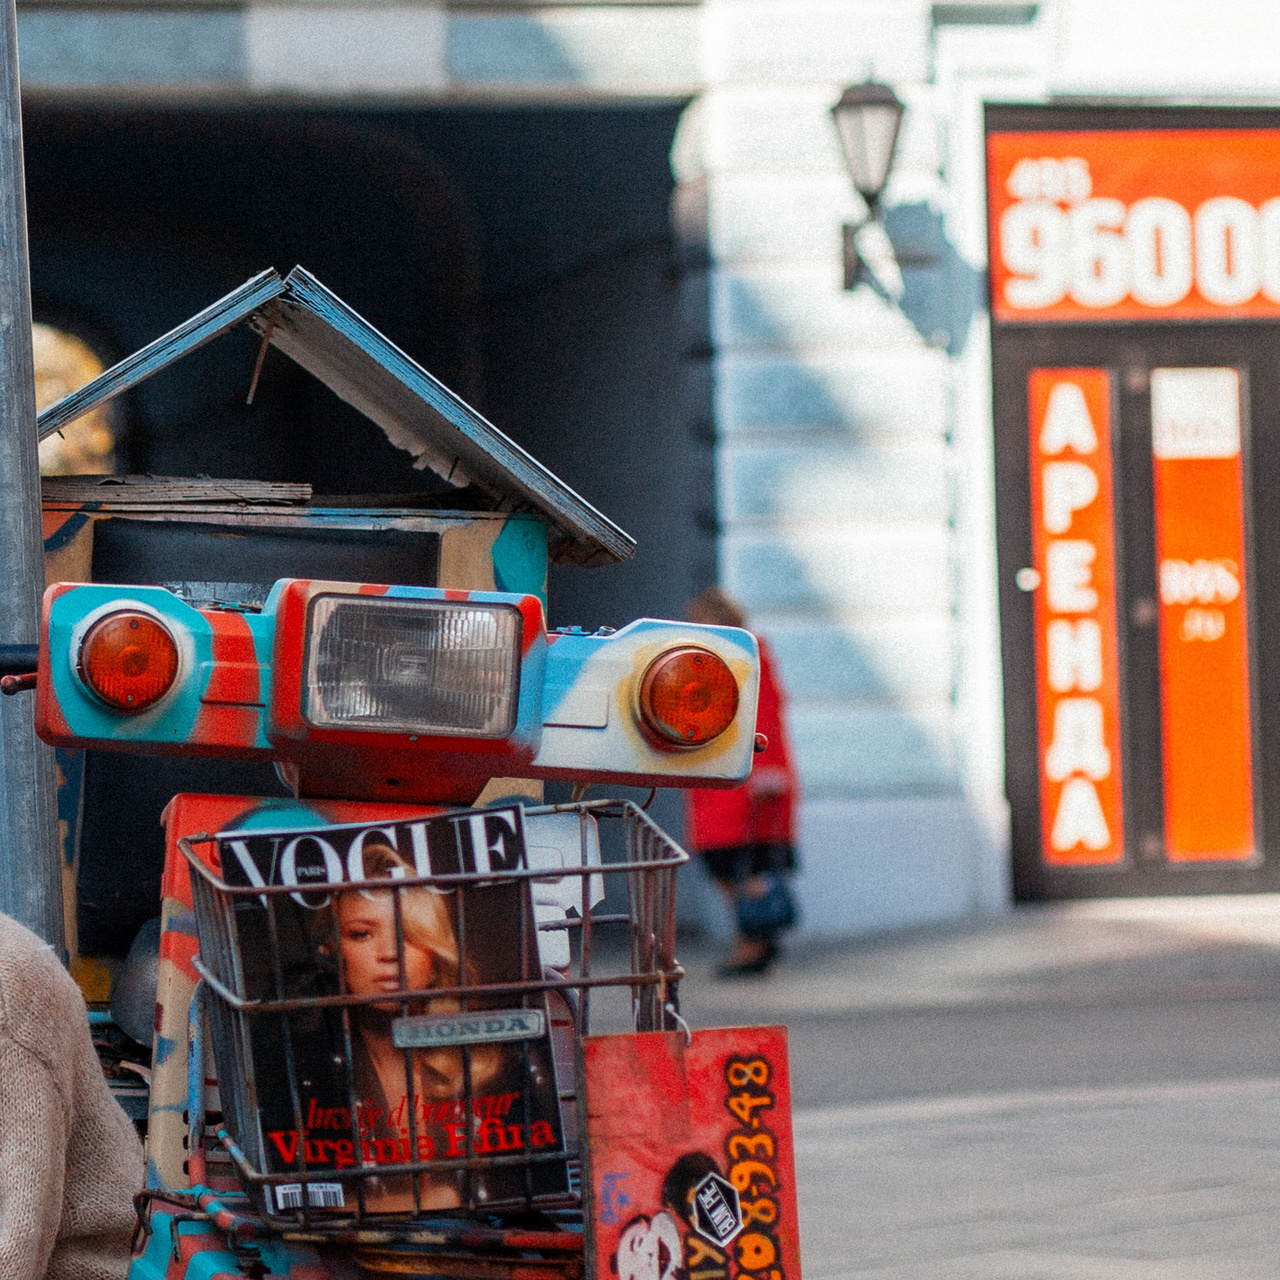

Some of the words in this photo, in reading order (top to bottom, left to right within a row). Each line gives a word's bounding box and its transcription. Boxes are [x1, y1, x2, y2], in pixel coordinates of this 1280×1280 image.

[225, 810, 524, 910] VOGUE
[268, 1126, 435, 1170] Virginie
[441, 1117, 557, 1158] Efira
